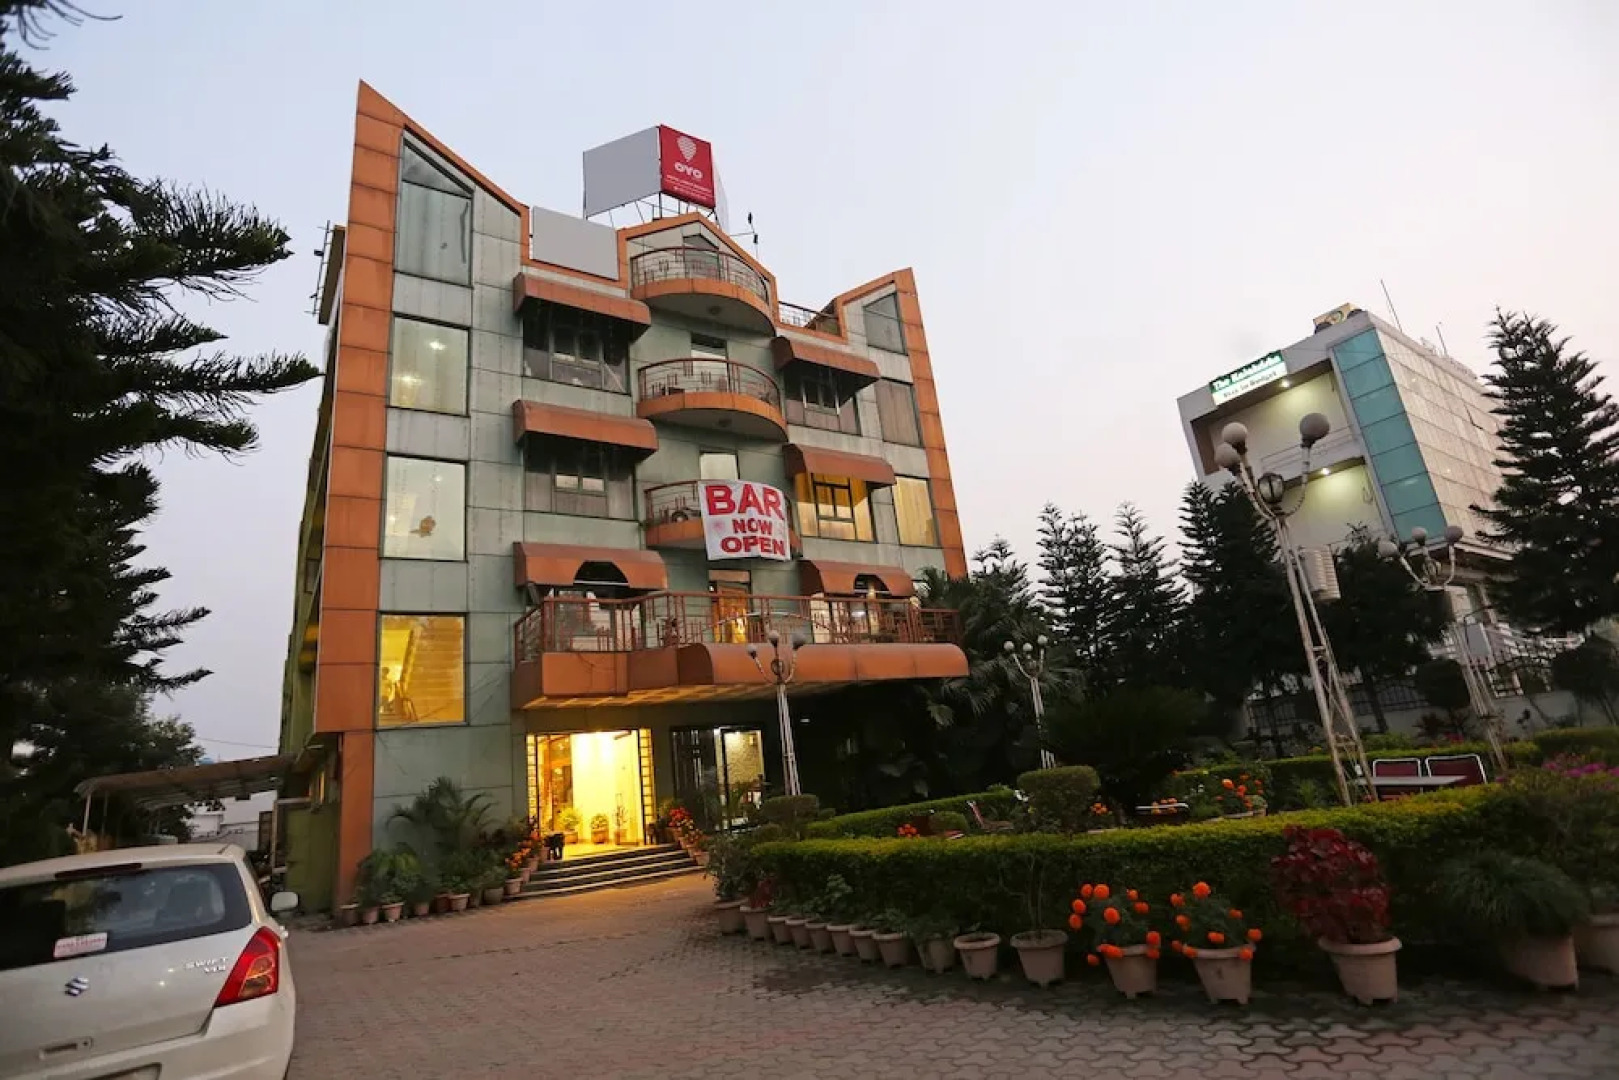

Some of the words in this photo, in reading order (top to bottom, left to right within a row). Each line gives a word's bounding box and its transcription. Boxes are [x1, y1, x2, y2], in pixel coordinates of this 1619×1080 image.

[674, 162, 703, 179] OYO
[705, 484, 784, 520] BAR
[732, 518, 772, 535] NOW
[720, 536, 786, 556] OPEN
[185, 956, 229, 969] SWIFT
